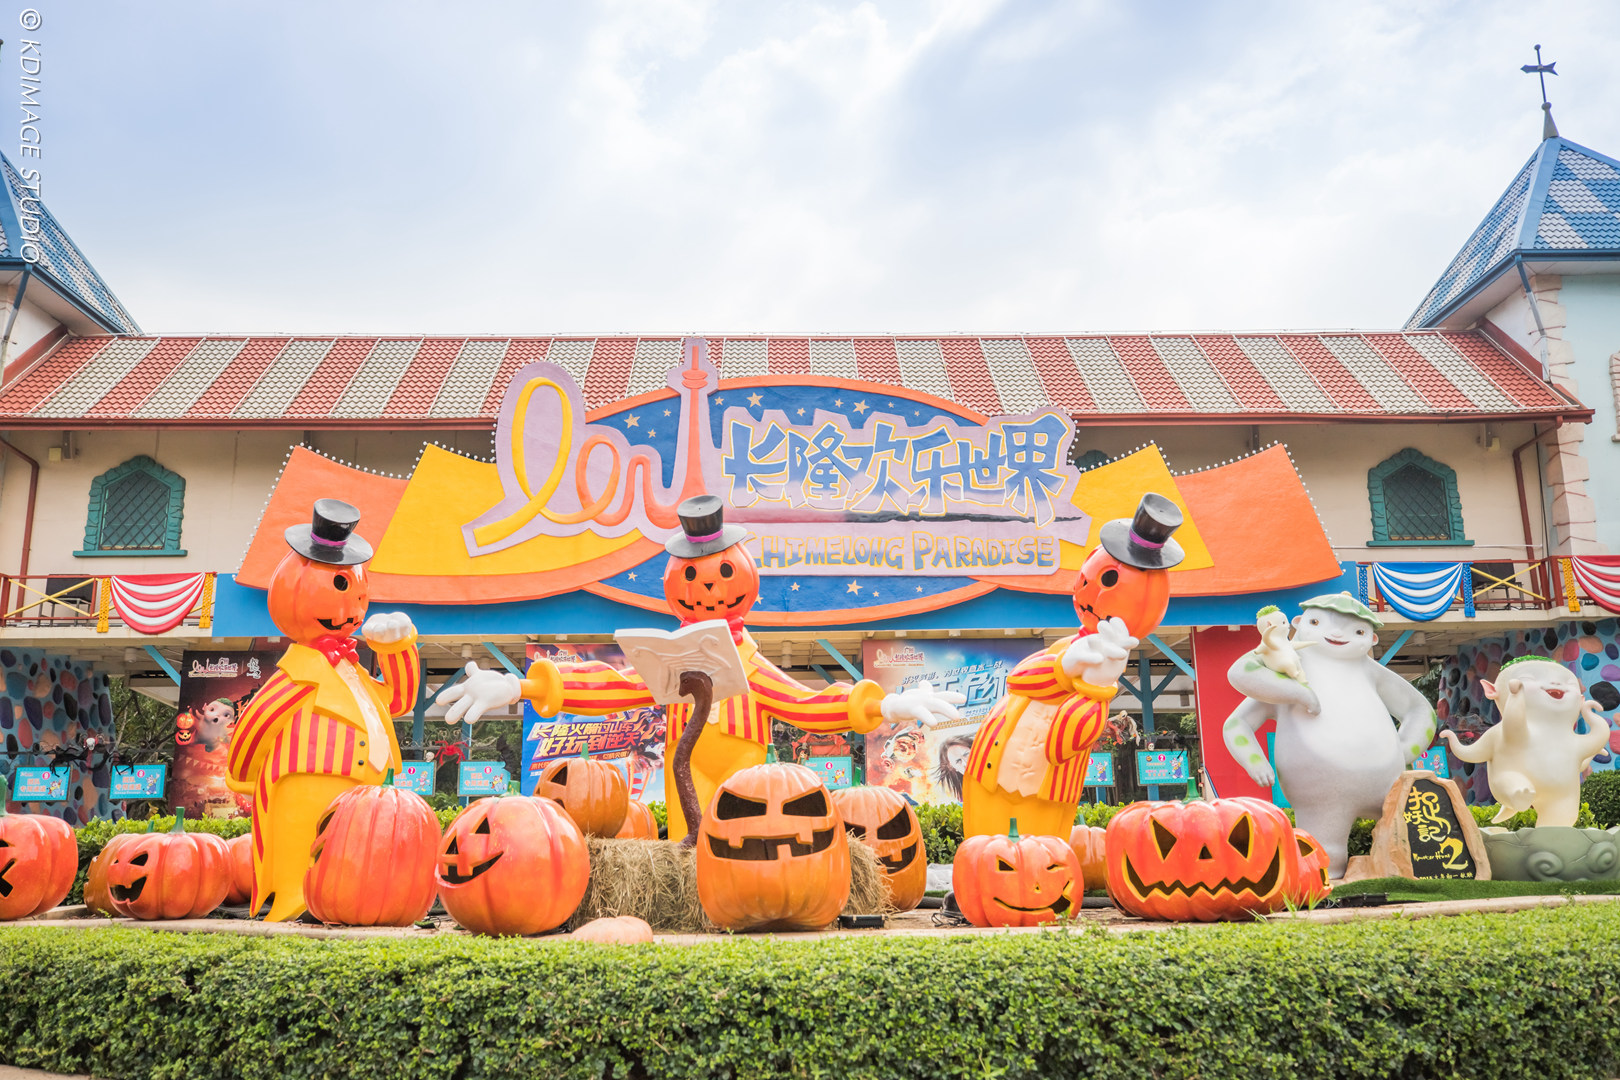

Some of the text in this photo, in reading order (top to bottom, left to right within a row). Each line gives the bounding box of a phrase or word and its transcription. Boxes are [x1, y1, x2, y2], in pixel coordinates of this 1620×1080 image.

[723, 412, 1070, 528] 长隆欢乐世界
[912, 531, 1056, 570] PARADISE
[536, 732, 640, 758] 好玩到逆天
[1439, 837, 1469, 871] 2
